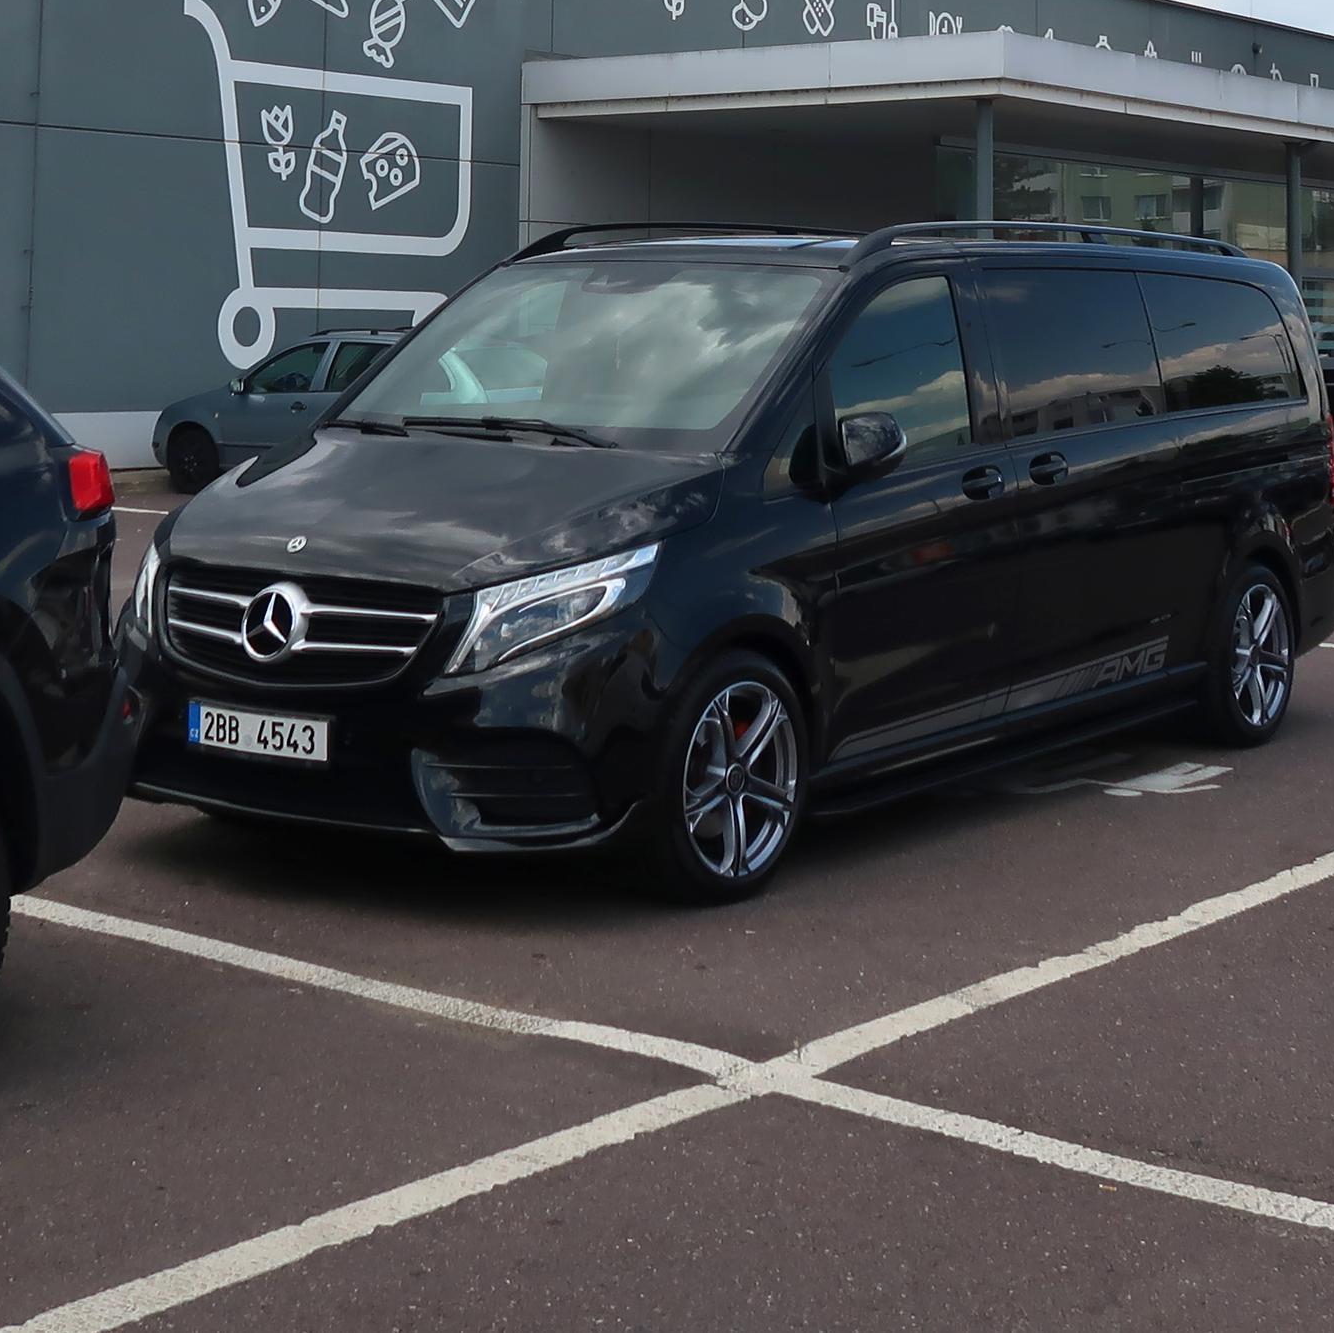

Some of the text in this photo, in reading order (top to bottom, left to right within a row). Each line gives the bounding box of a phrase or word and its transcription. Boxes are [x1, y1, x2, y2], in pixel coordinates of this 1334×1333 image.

[1093, 642, 1168, 688] AMG
[204, 711, 315, 755] 2BB 4543
